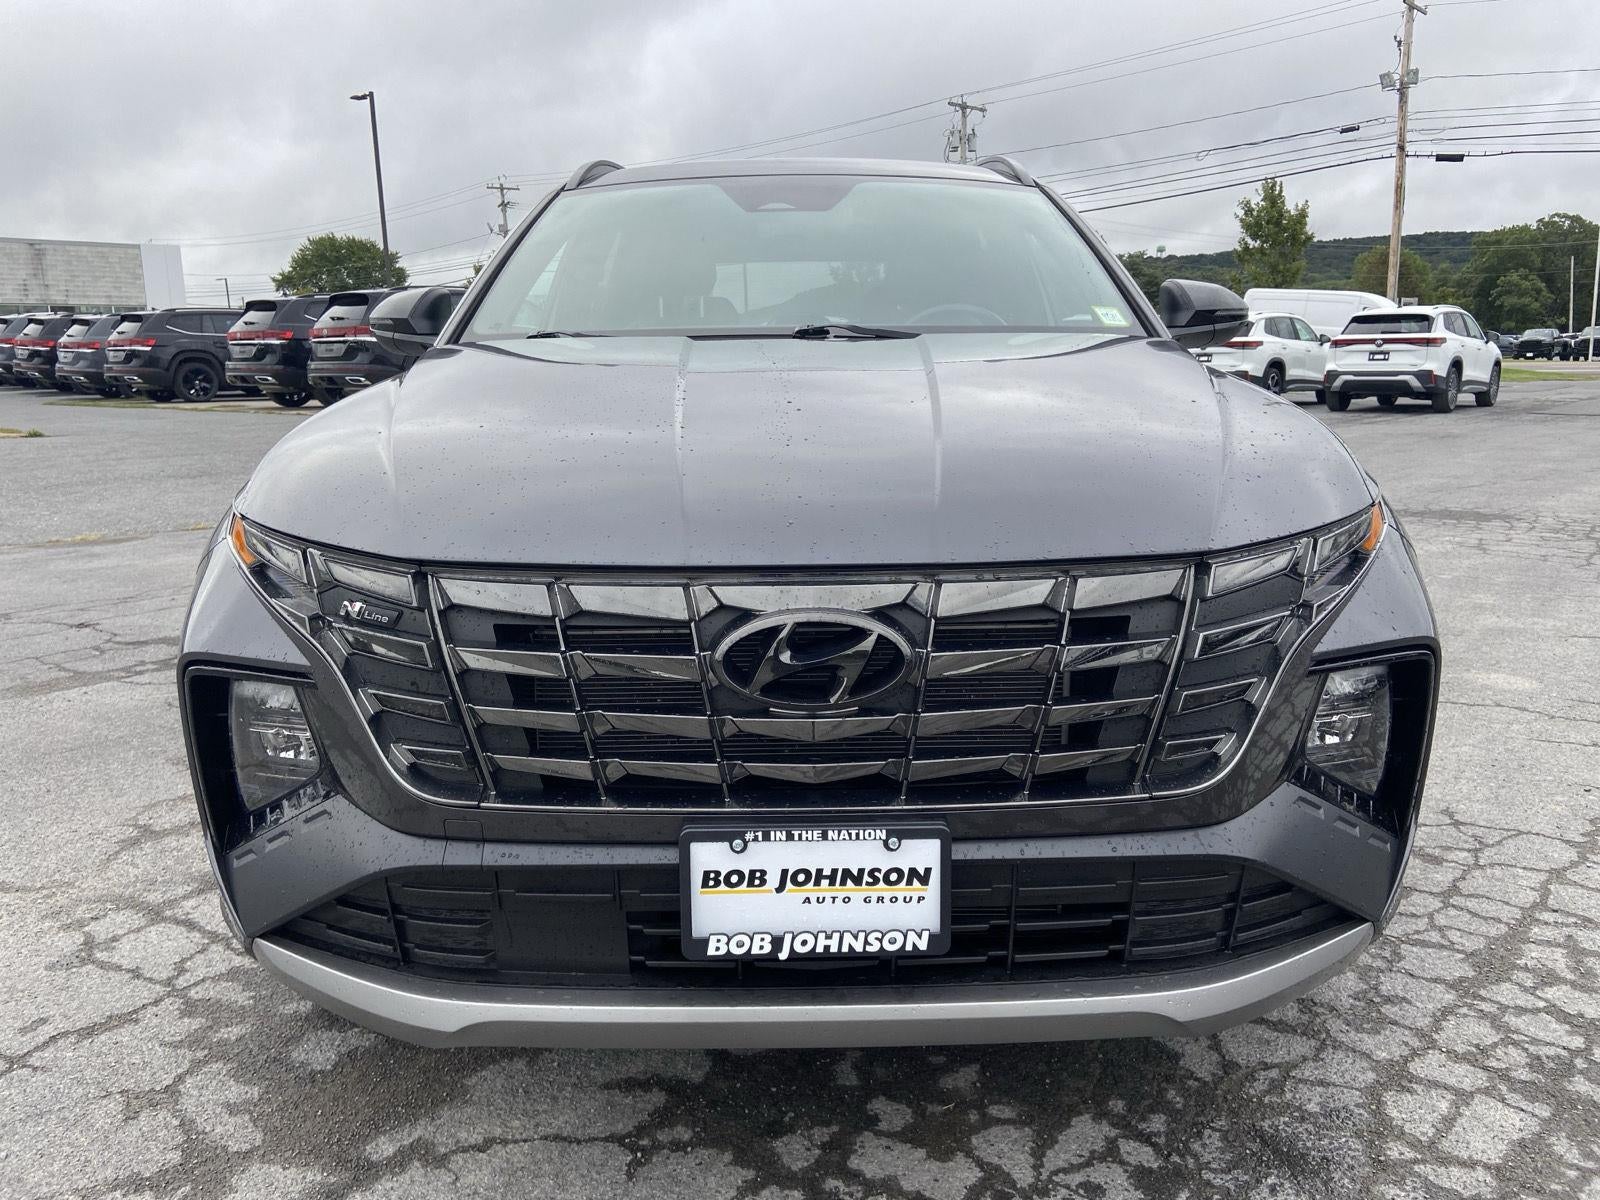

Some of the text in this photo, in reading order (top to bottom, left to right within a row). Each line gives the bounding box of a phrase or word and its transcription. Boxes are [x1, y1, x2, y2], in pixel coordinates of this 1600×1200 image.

[364, 610, 389, 623] Line
[745, 829, 887, 842] #1 IN THE NATION
[701, 866, 933, 894] BOB JOHNSON
[802, 895, 926, 905] AUTO GROUP
[706, 930, 930, 961] BOB JOHNSON
